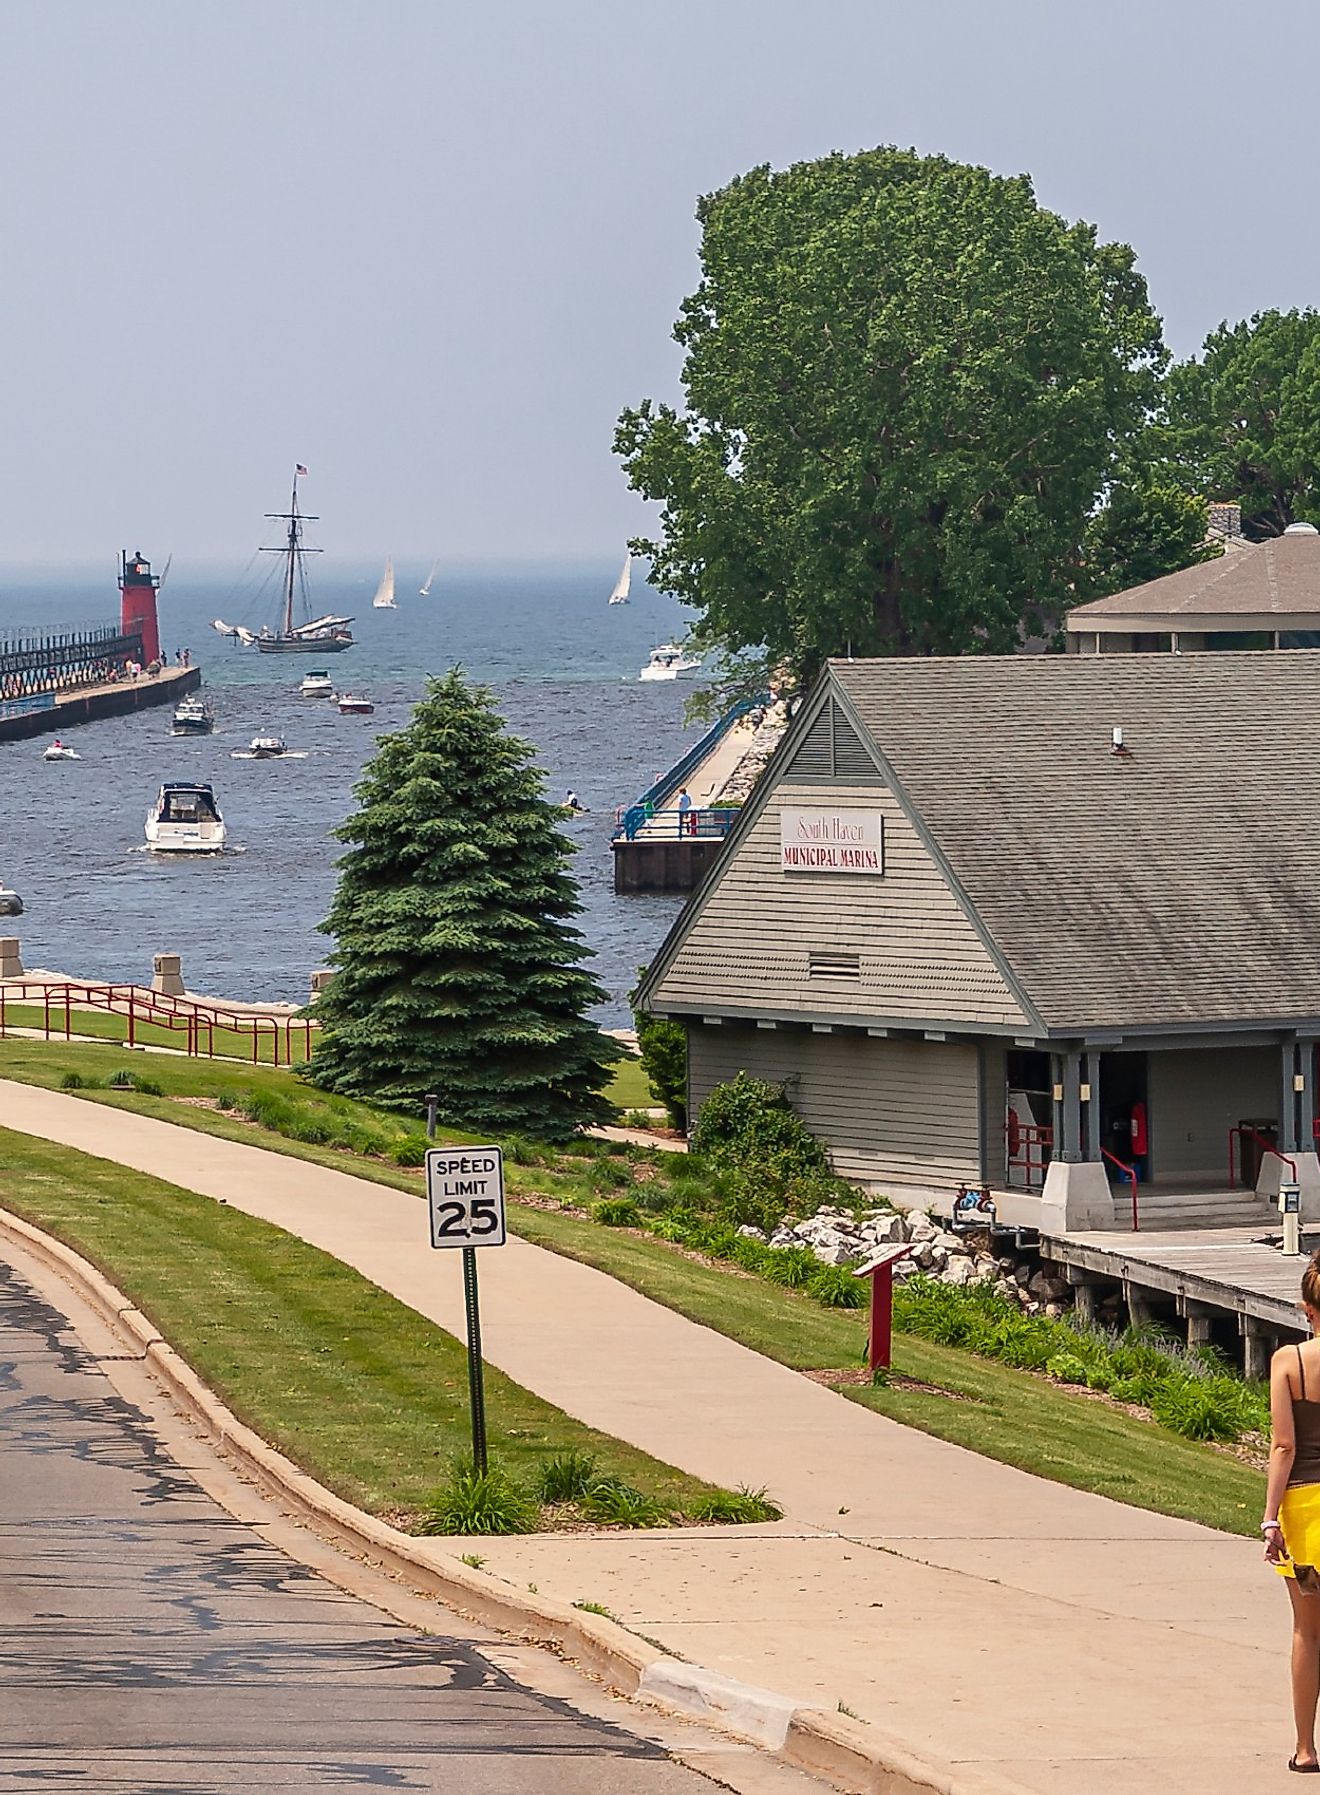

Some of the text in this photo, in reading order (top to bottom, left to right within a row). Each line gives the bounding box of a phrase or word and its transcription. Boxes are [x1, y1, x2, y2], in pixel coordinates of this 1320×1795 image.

[797, 816, 863, 841] South Haven
[784, 847, 879, 869] MUNICIPAL MARINA
[436, 1158, 495, 1175] SPEED
[444, 1181, 488, 1195] LIMIT
[437, 1199, 498, 1238] 25
